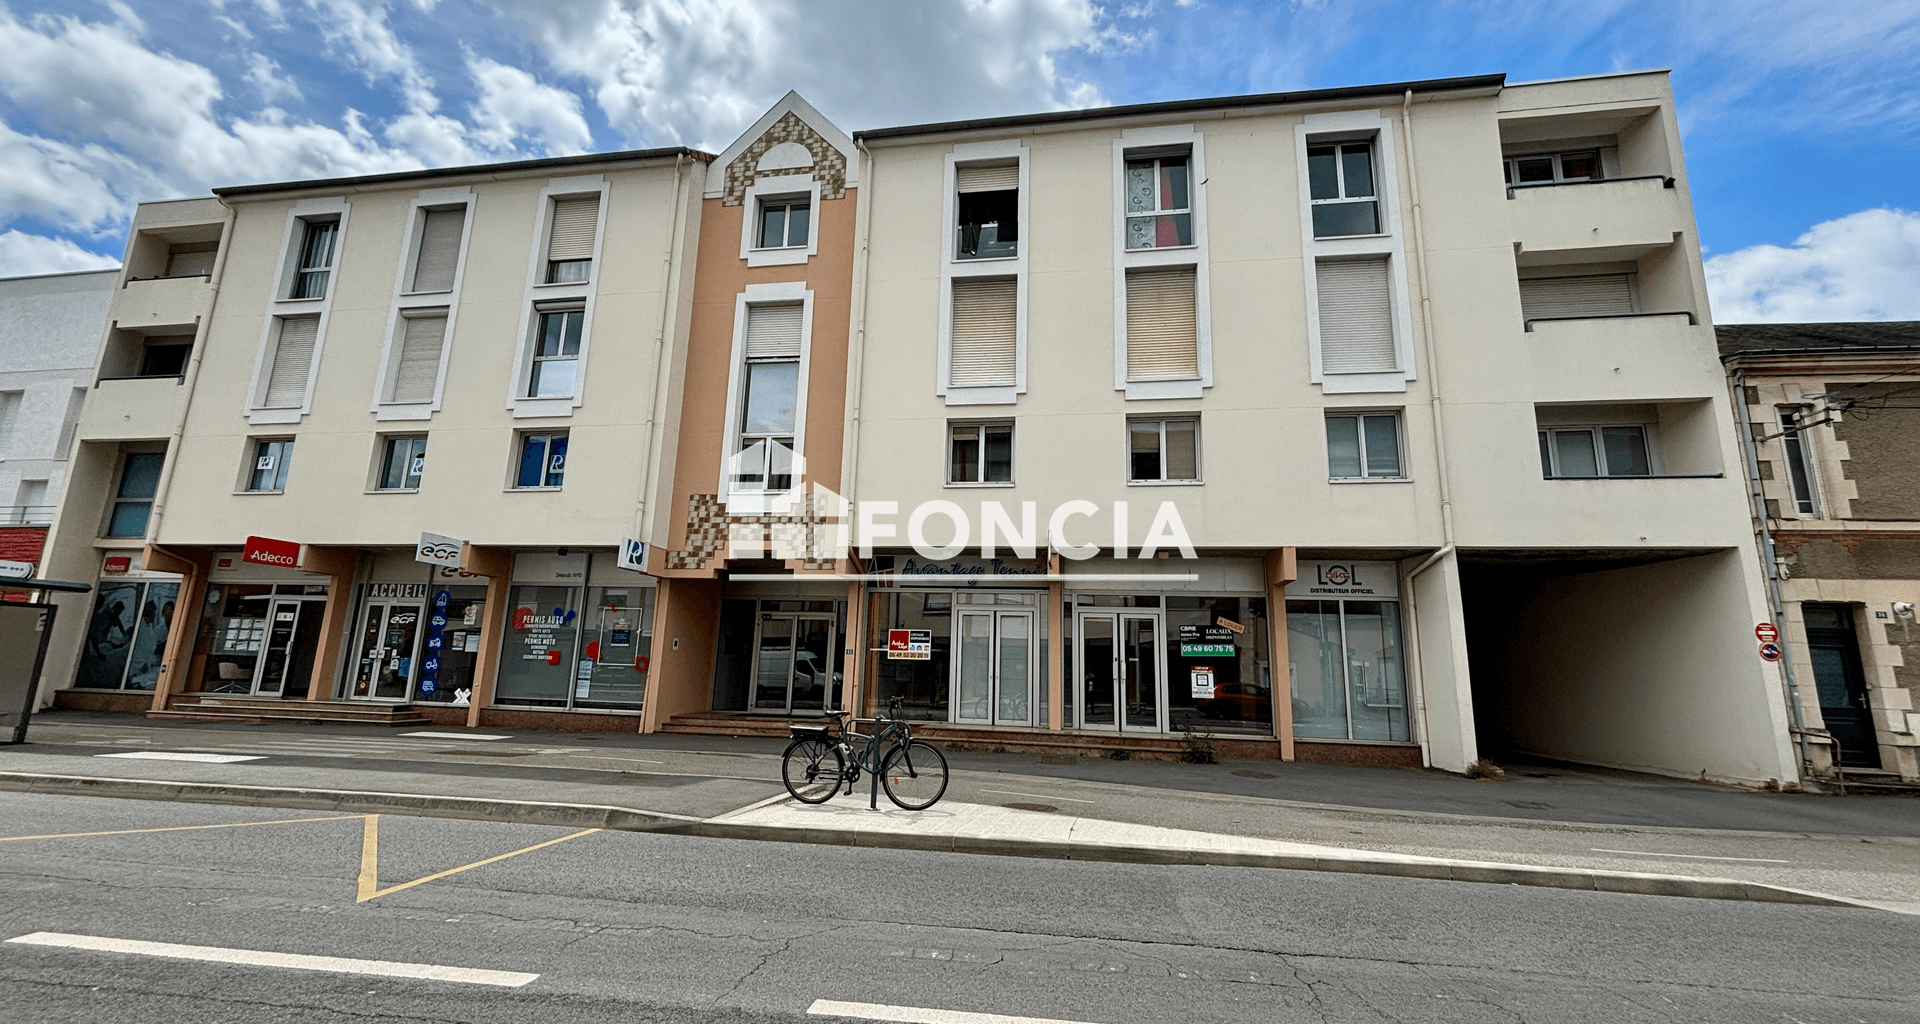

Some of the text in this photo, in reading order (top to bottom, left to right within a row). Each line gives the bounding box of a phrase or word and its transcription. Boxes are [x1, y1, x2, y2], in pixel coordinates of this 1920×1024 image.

[250, 550, 294, 565] Adecco
[990, 558, 1048, 576] Tennis
[371, 584, 425, 598] ACCUEIL
[522, 615, 564, 625] PERMIS AUTO
